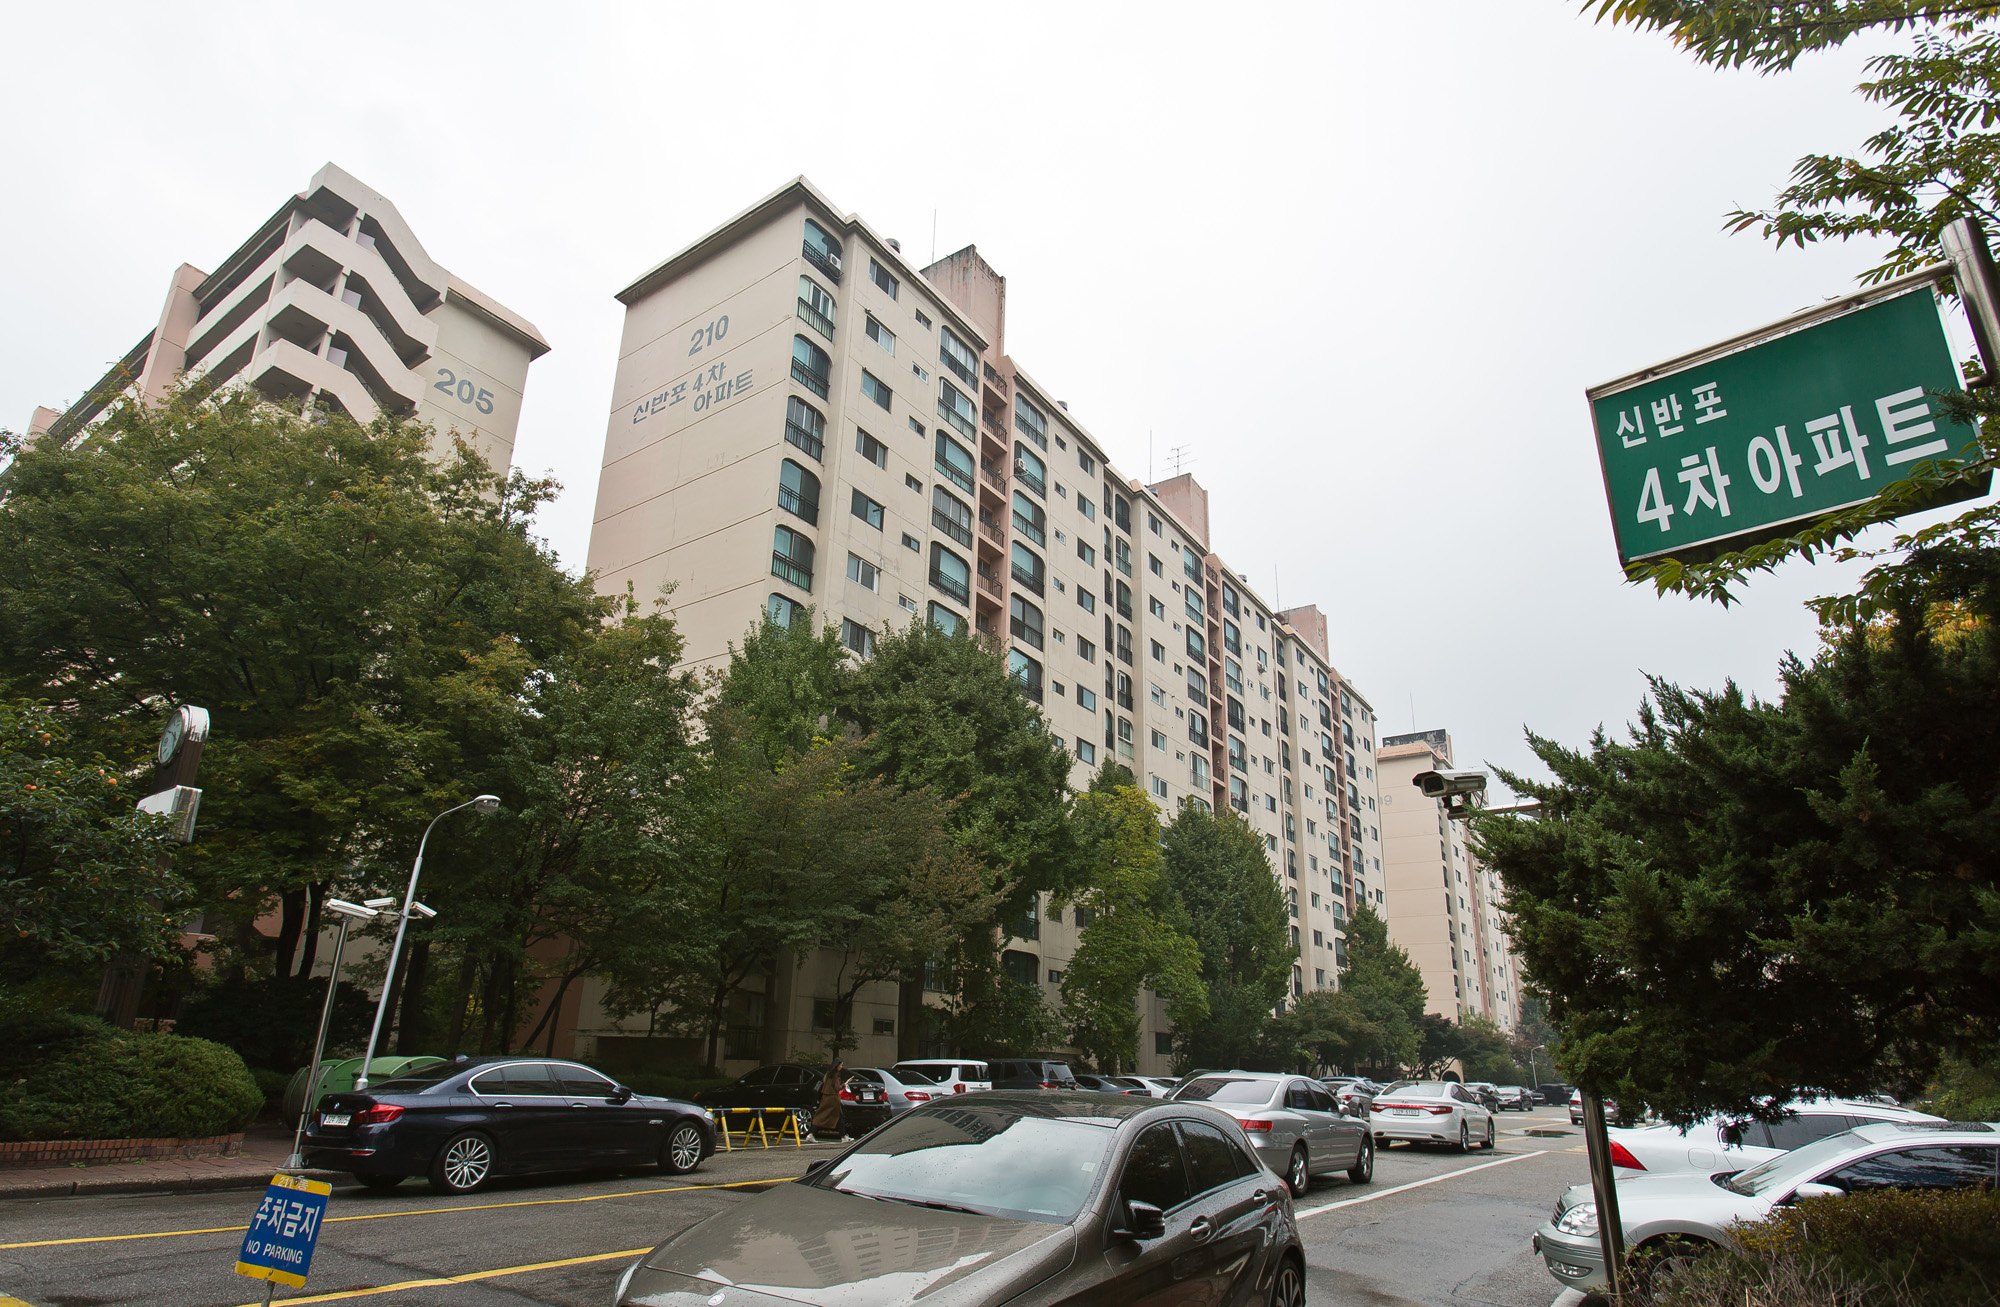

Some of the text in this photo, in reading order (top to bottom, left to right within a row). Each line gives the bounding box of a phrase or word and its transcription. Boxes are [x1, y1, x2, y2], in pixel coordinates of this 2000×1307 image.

[688, 315, 729, 357] 210
[433, 368, 494, 415] 205
[632, 361, 727, 425] 신반포 4차
[693, 369, 753, 413] 아파트
[1615, 381, 1728, 449] 신반포
[1636, 386, 1949, 532] 4차 아파트
[255, 1196, 320, 1242] 주차금지
[245, 1239, 303, 1264] NO PARKING
